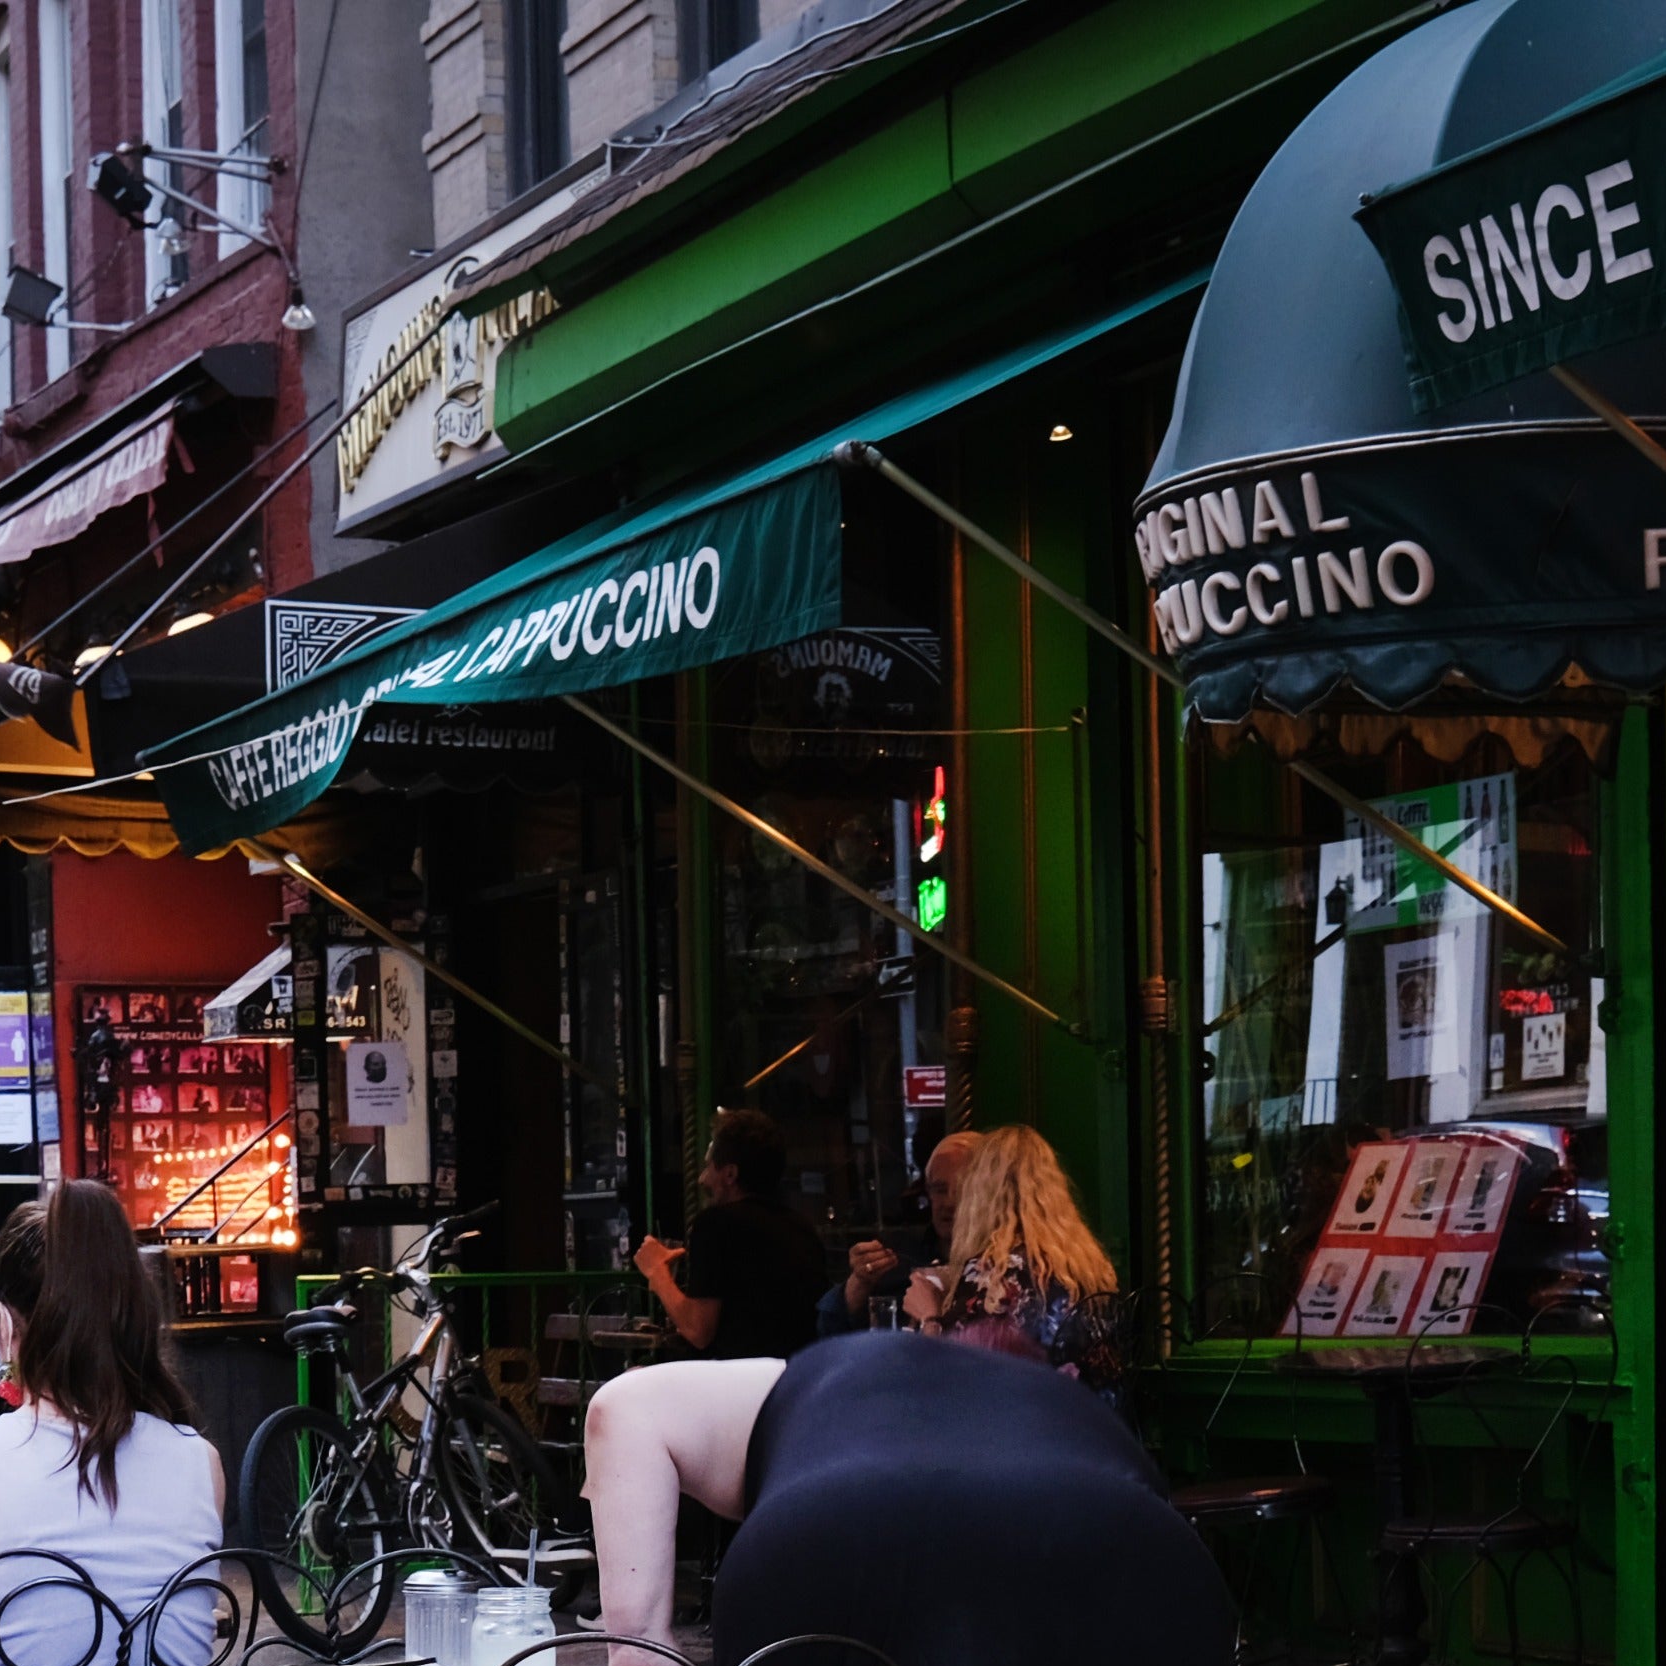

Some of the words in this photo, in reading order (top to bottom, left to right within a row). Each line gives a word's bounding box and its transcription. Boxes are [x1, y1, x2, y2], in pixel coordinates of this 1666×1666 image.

[1423, 159, 1654, 344] SINCE
[208, 738, 274, 811] CAFFE
[270, 698, 350, 792] REGGIO
[453, 545, 721, 683] CAPPUCCINO
